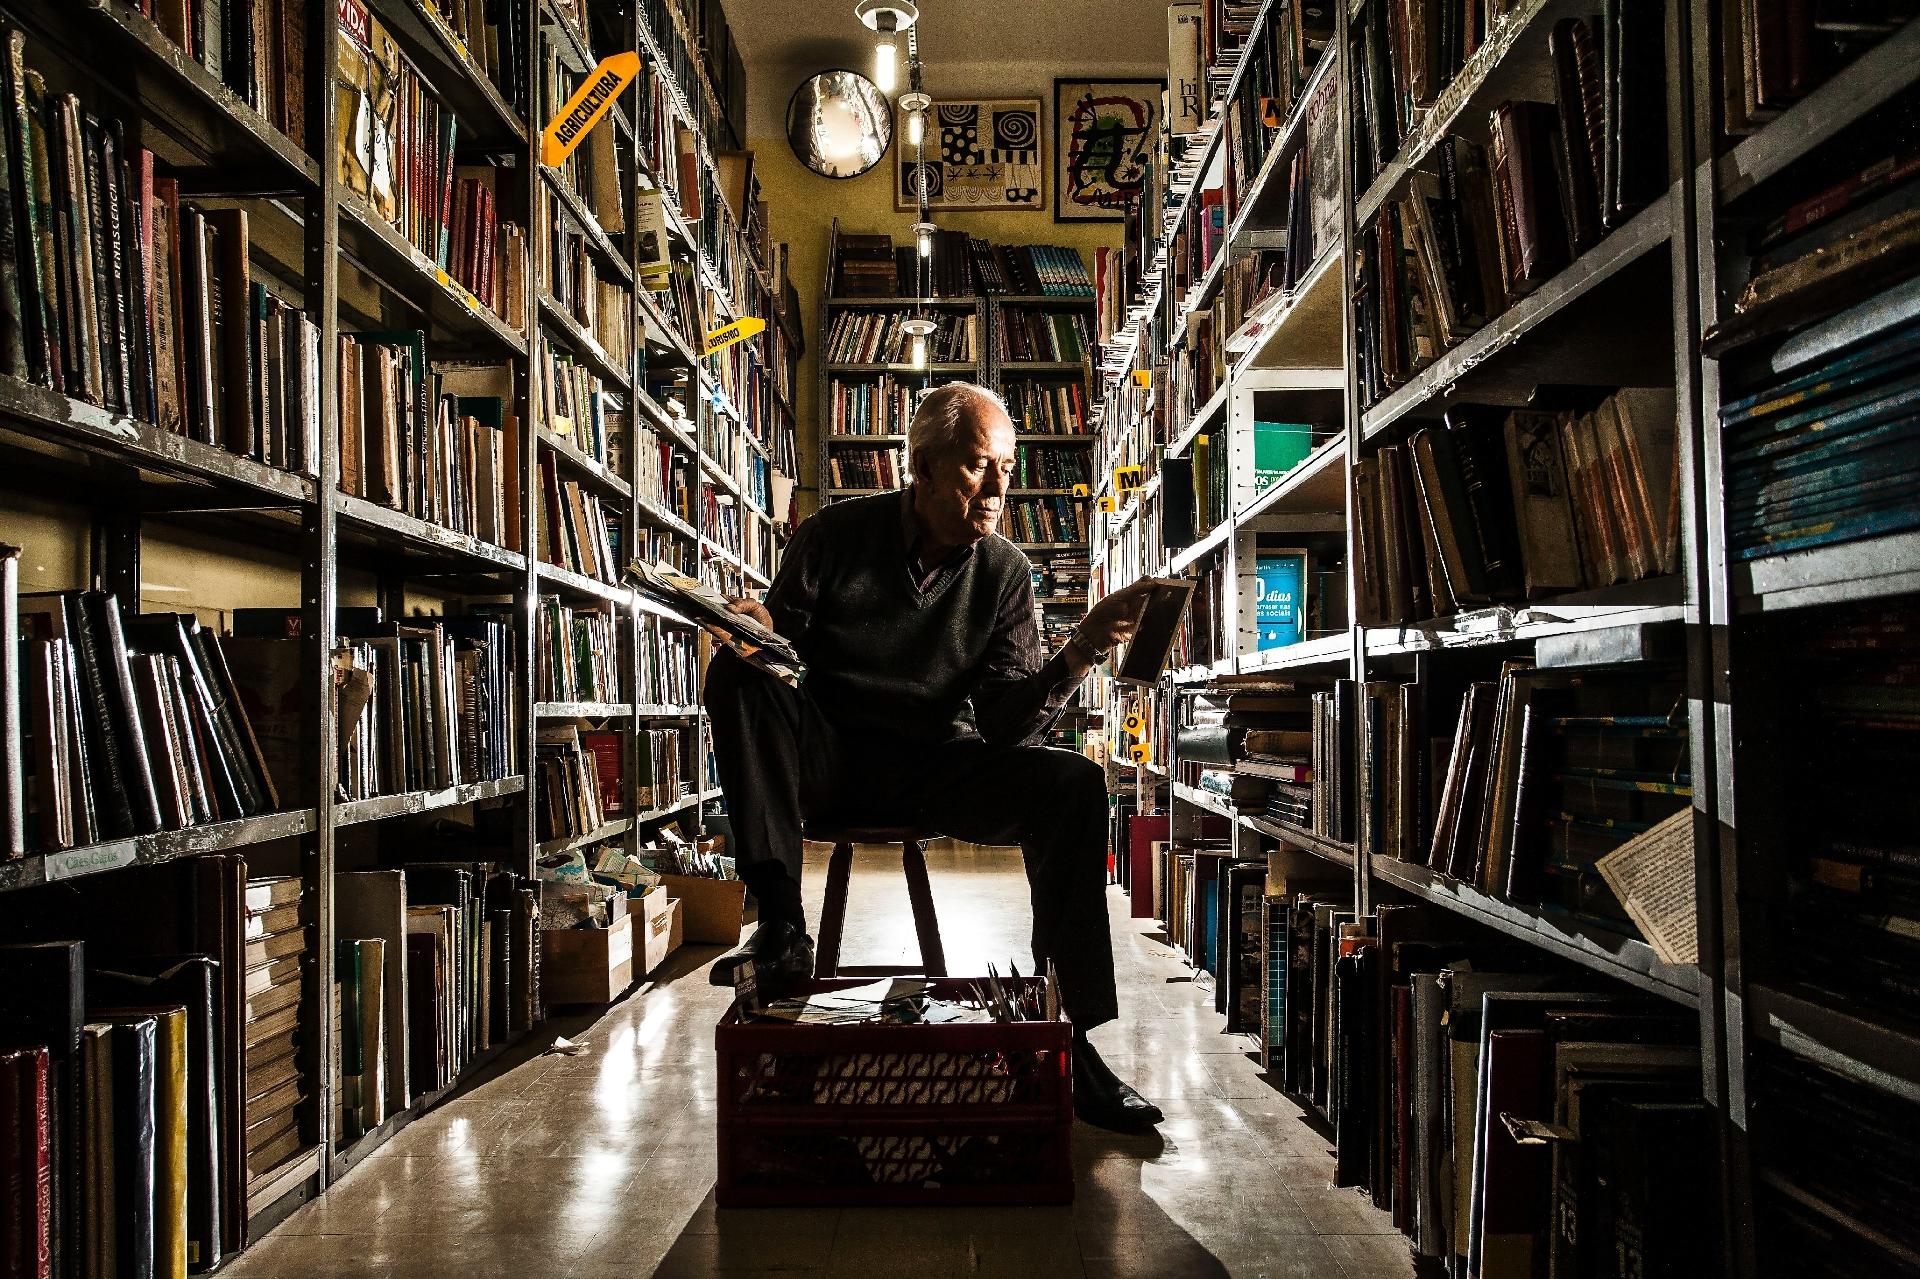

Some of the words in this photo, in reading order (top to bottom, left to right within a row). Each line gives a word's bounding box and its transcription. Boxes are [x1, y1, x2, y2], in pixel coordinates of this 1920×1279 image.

[554, 69, 623, 147] AGRICULTURA
[1264, 101, 1281, 119] A
[1118, 470, 1141, 490] M
[1075, 488, 1083, 497] A
[1100, 501, 1109, 512] F
[1265, 589, 1291, 602] dias
[1126, 716, 1138, 728] O
[1133, 750, 1144, 763] P
